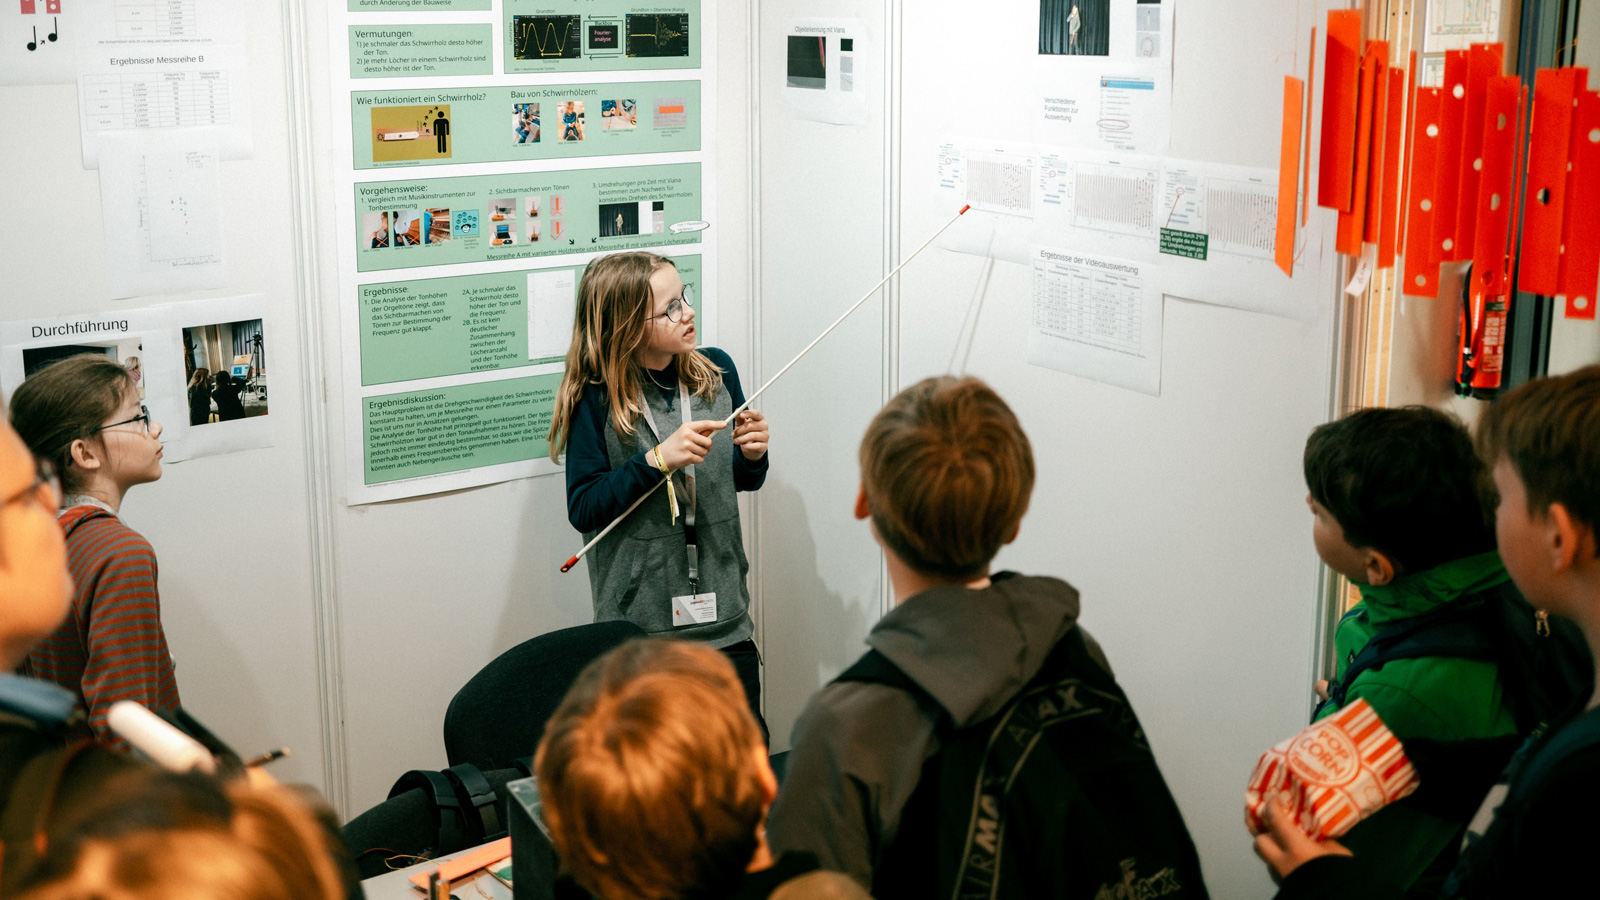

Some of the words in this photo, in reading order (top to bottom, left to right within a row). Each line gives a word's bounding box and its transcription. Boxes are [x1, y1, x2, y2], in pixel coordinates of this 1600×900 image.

[110, 56, 154, 66] Ergebnisse
[156, 55, 196, 63] Messreihe
[542, 88, 598, 97] Schwirrhölzern:
[374, 95, 421, 104] funktioniert
[437, 93, 486, 102] Schwirrholz?
[360, 185, 428, 196] Vorgehensweise:
[495, 186, 540, 194] Sichtbarmachen
[367, 195, 395, 204] Vergleich
[408, 192, 465, 200] Musikinstrumenten
[663, 237, 698, 246] Löcheranzahl
[1040, 250, 1072, 261] Ergebnisse
[1073, 255, 1083, 263] der
[1085, 258, 1138, 274] Videoauswertung
[364, 286, 409, 297] Ergebnisse:
[469, 293, 501, 301] Schwirrholz
[382, 296, 405, 304] Analyse
[383, 303, 413, 313] Orgeltöne
[384, 309, 431, 319] Sichtbarmachen
[32, 320, 128, 338] Durchführung
[470, 331, 515, 340] Zusammenhang
[470, 346, 507, 355] Löcheranzahl
[369, 394, 446, 409] Ergebnisdiskussion:
[382, 405, 425, 416] Hauptproblem
[444, 395, 503, 408] Drehgeschwindigkeit
[515, 389, 552, 399] Schwirrholzes
[1317, 730, 1349, 759] POP
[1300, 737, 1346, 776] CORN
